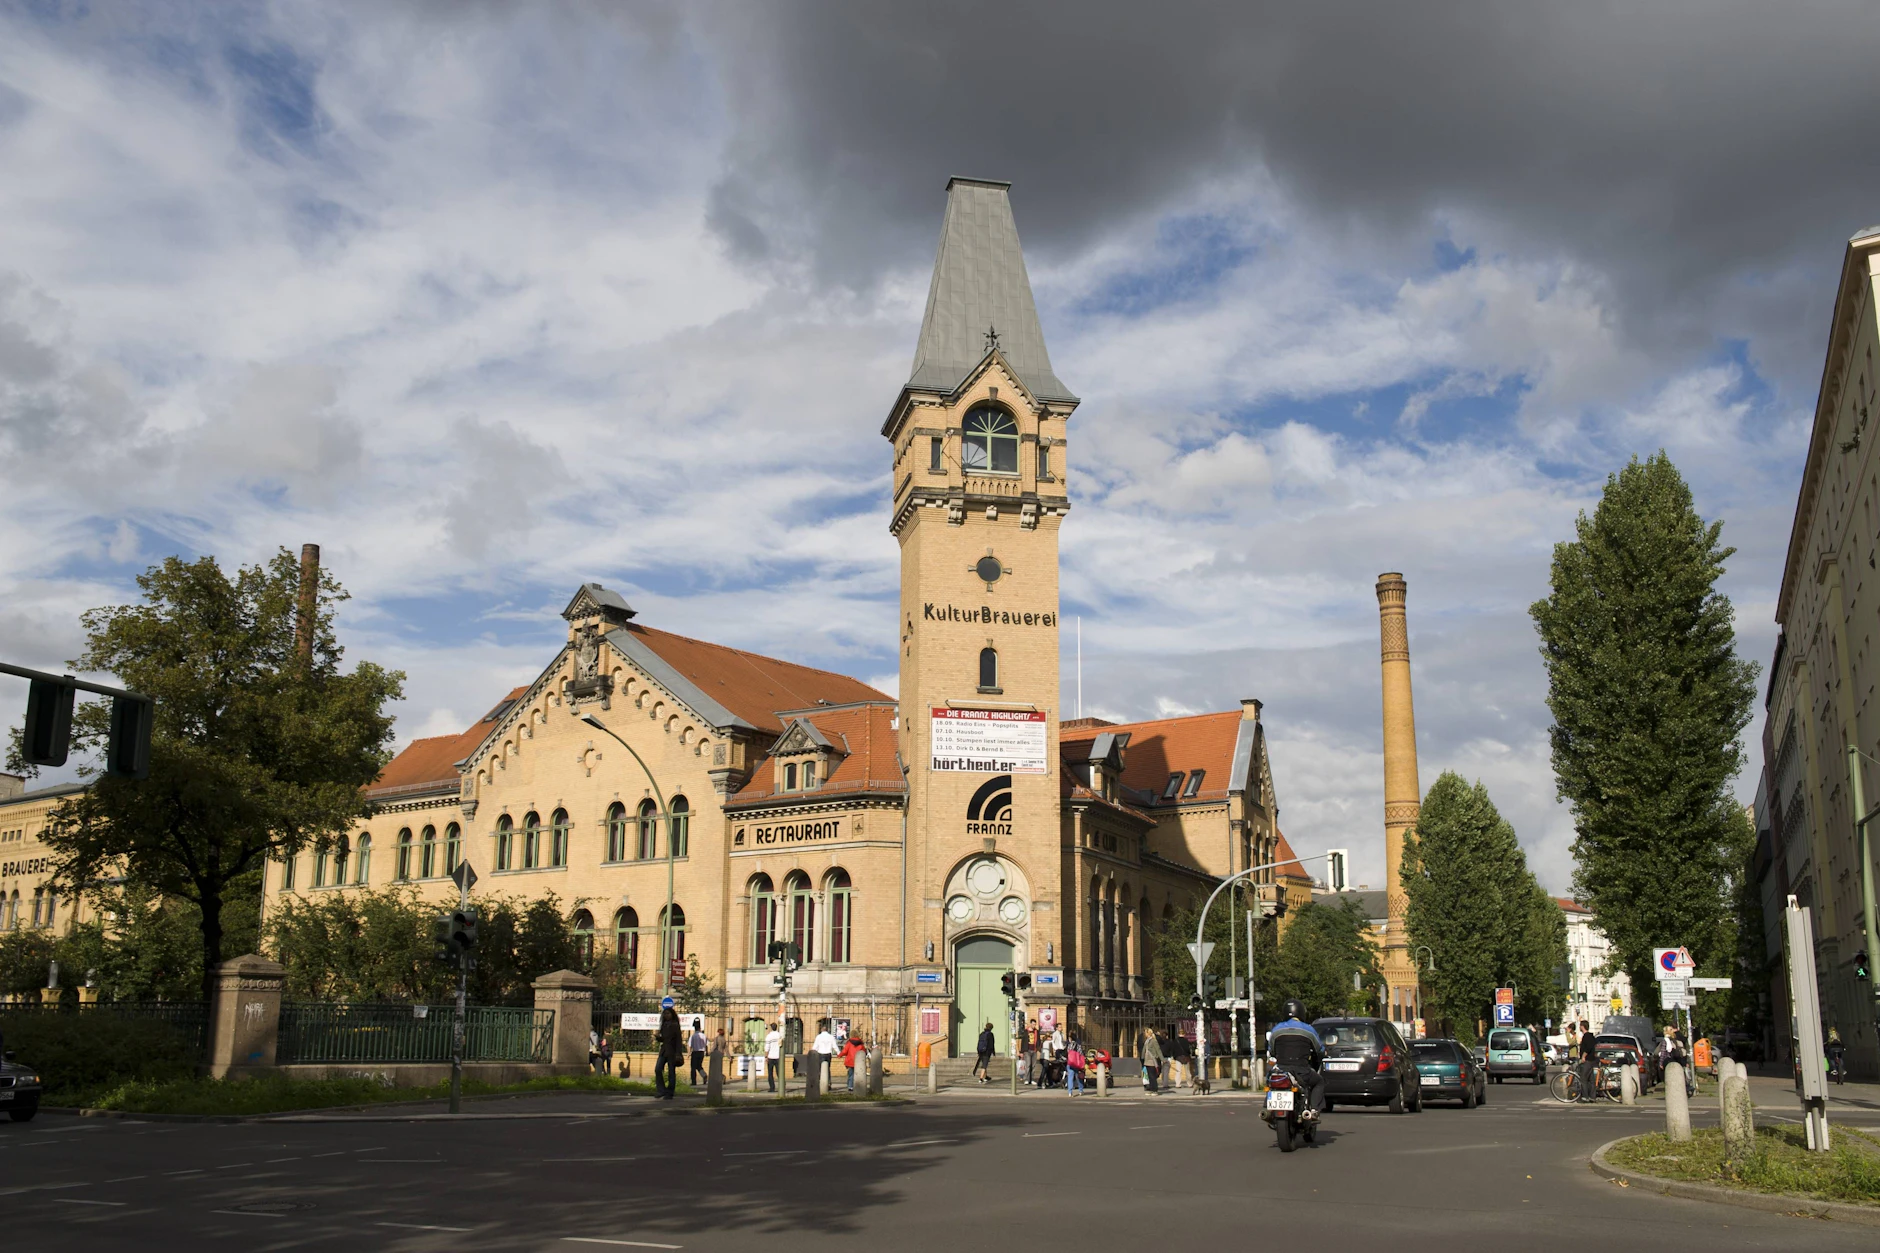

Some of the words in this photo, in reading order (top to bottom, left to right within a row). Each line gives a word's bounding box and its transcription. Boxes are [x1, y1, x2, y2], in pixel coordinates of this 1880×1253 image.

[924, 602, 1056, 627] KulturBrauerei
[947, 710, 959, 718] DIE
[961, 711, 989, 719] FRANNZ
[991, 712, 1031, 720] HIGHLIGHTS
[933, 757, 1016, 772] hörtheater
[756, 821, 840, 844] RESTAURANT
[966, 823, 1012, 835] FRANNZ
[2, 857, 49, 877] BRAUEREI
[1501, 1008, 1510, 1019] P
[1268, 1101, 1277, 1109] XJ
